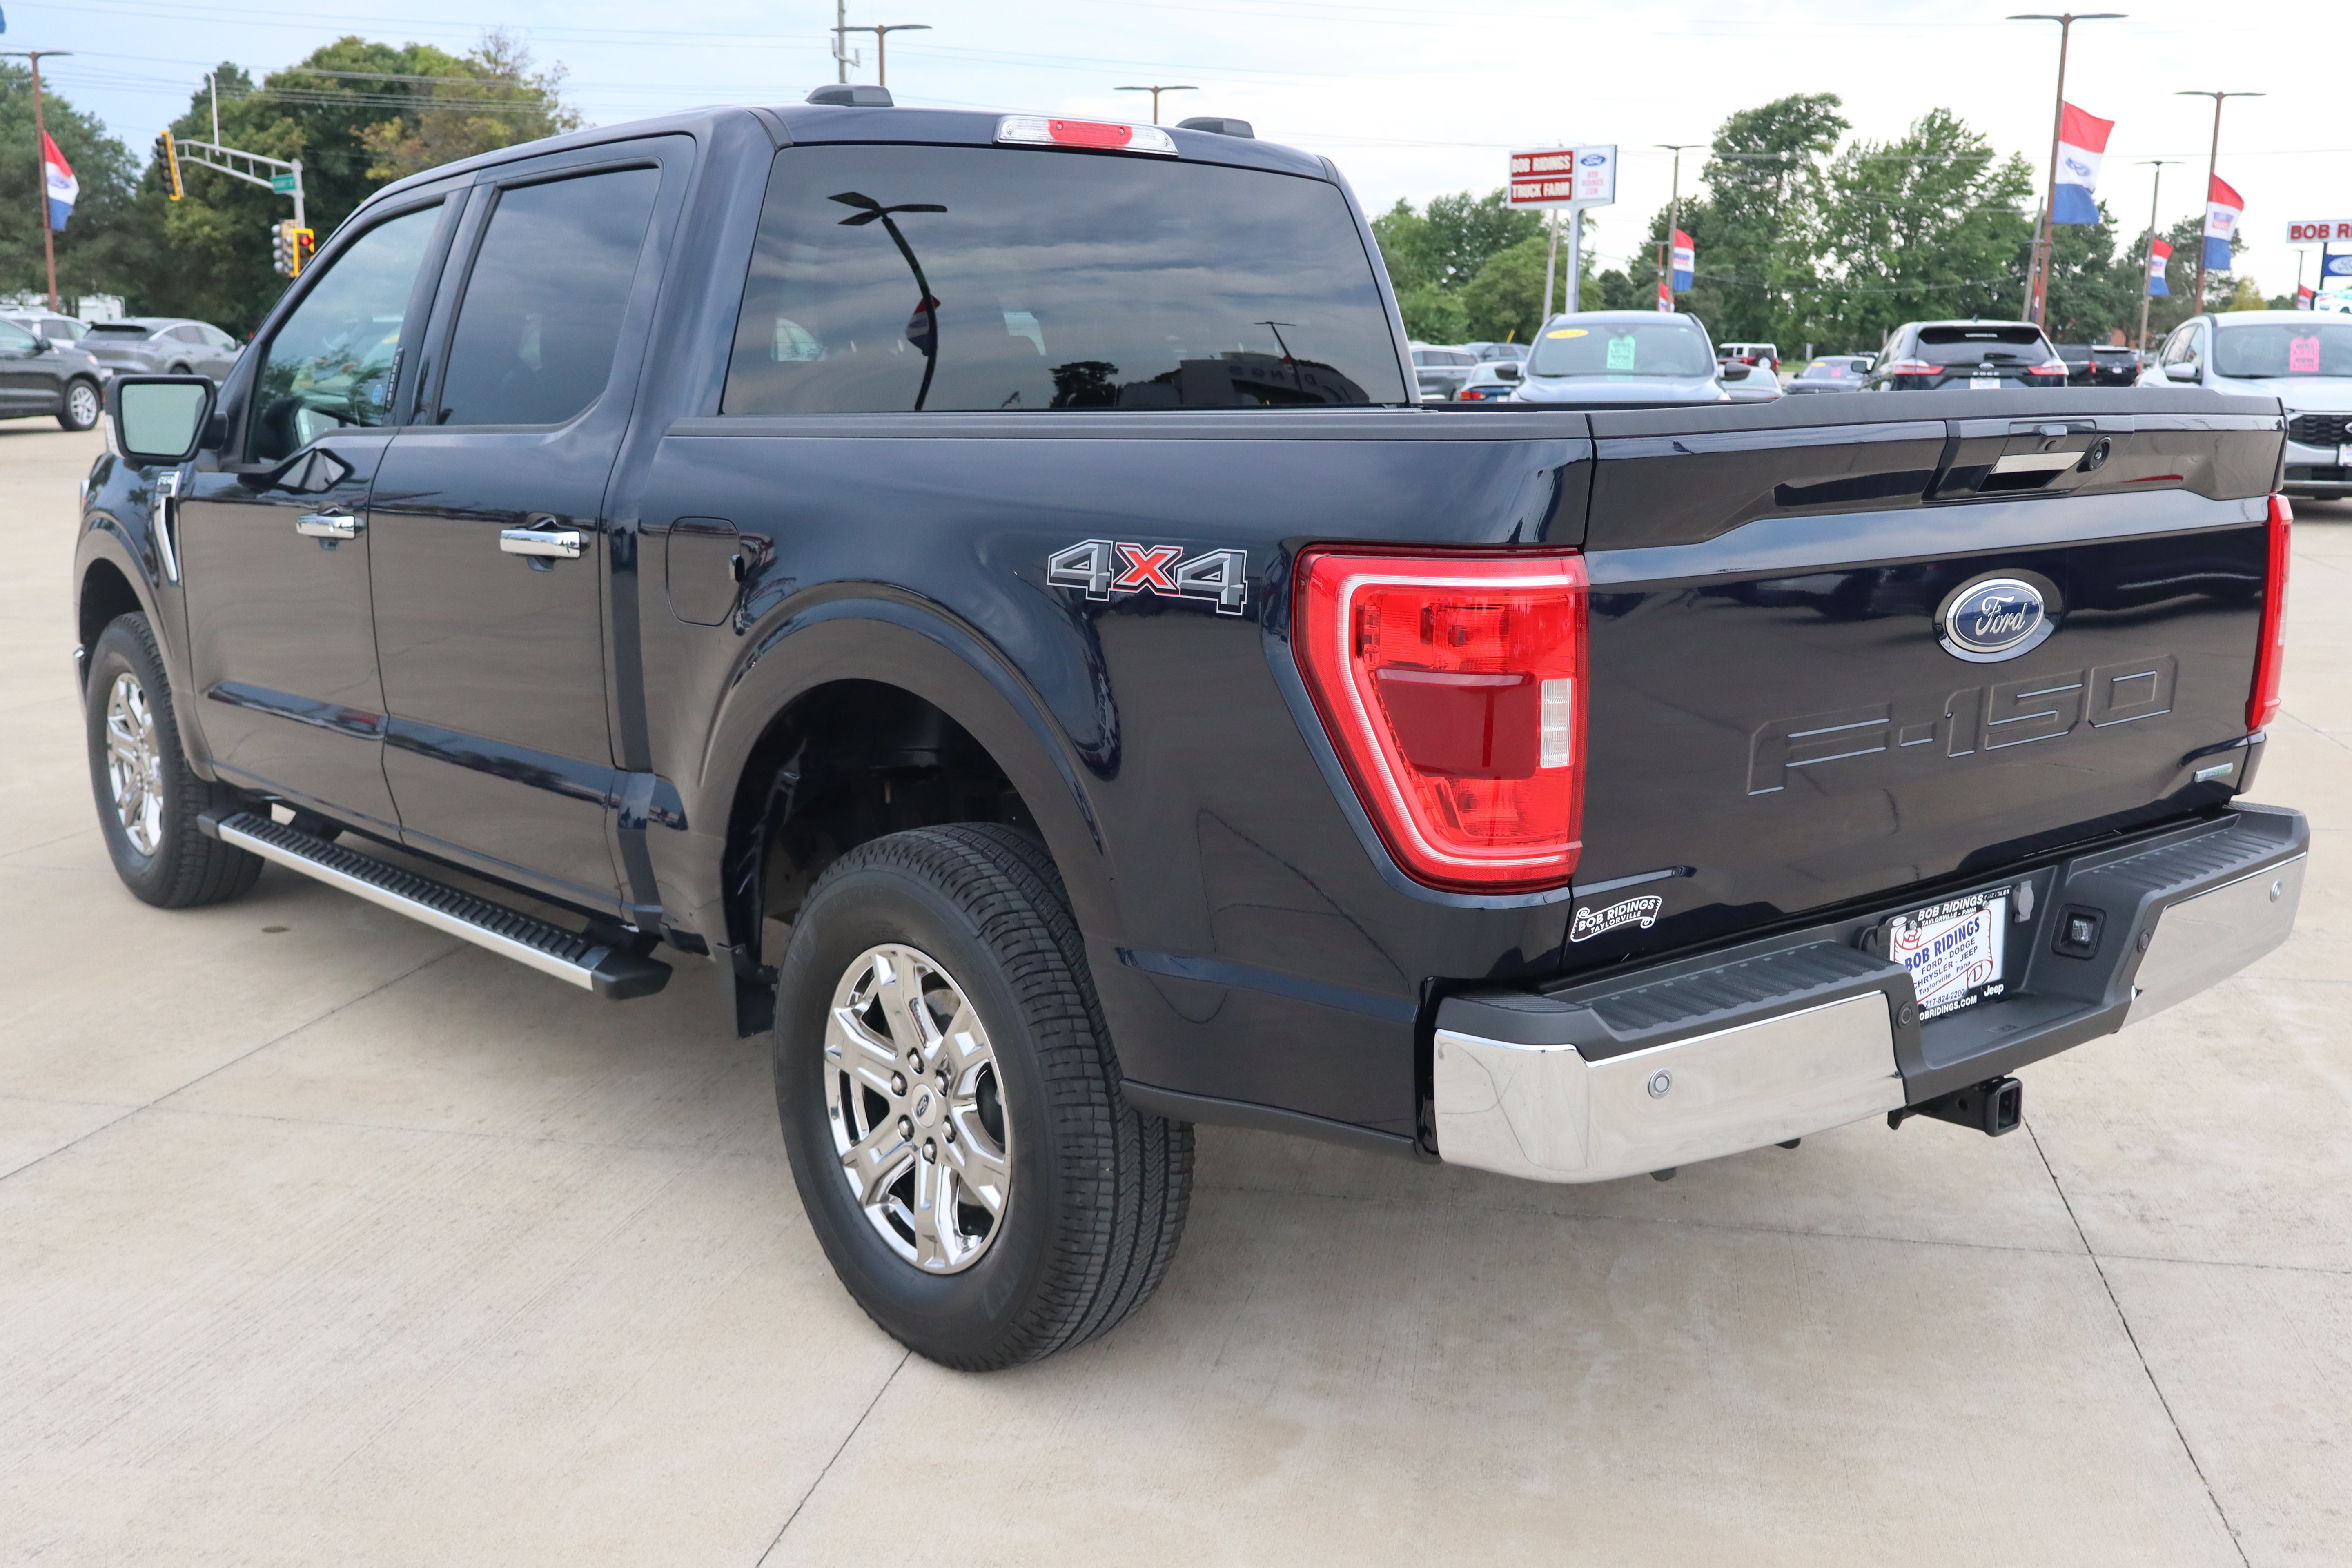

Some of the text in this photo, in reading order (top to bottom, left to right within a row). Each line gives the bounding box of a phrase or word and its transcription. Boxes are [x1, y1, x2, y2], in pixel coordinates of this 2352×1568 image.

[1512, 155, 1571, 173] BOB RIDINGS
[1512, 181, 1570, 198] TRUCK FARM
[2291, 224, 2330, 240] BOB
[1975, 595, 2027, 636] Ford
[1747, 654, 2178, 796] F-150
[1578, 899, 1655, 931] BOB RIDINGS
[1918, 906, 1940, 922] BOB
[1942, 894, 1984, 914] RIDINGS
[1921, 912, 1958, 927] TAYLORVILLE
[1962, 906, 1977, 916] PANA
[1590, 911, 1642, 934] TAYLORVILLE
[1905, 917, 1980, 972] BOB RIDINGS
[1922, 958, 1942, 975] FORD
[1949, 937, 1976, 958] DODGE
[1960, 945, 1978, 962] JEEP
[1919, 960, 1971, 995] Taylorville Pana
[1925, 989, 1965, 1008] 217-824-2200
[1984, 984, 2005, 997] Jeep
[1919, 995, 1977, 1021] OBRIDINGS.COM
